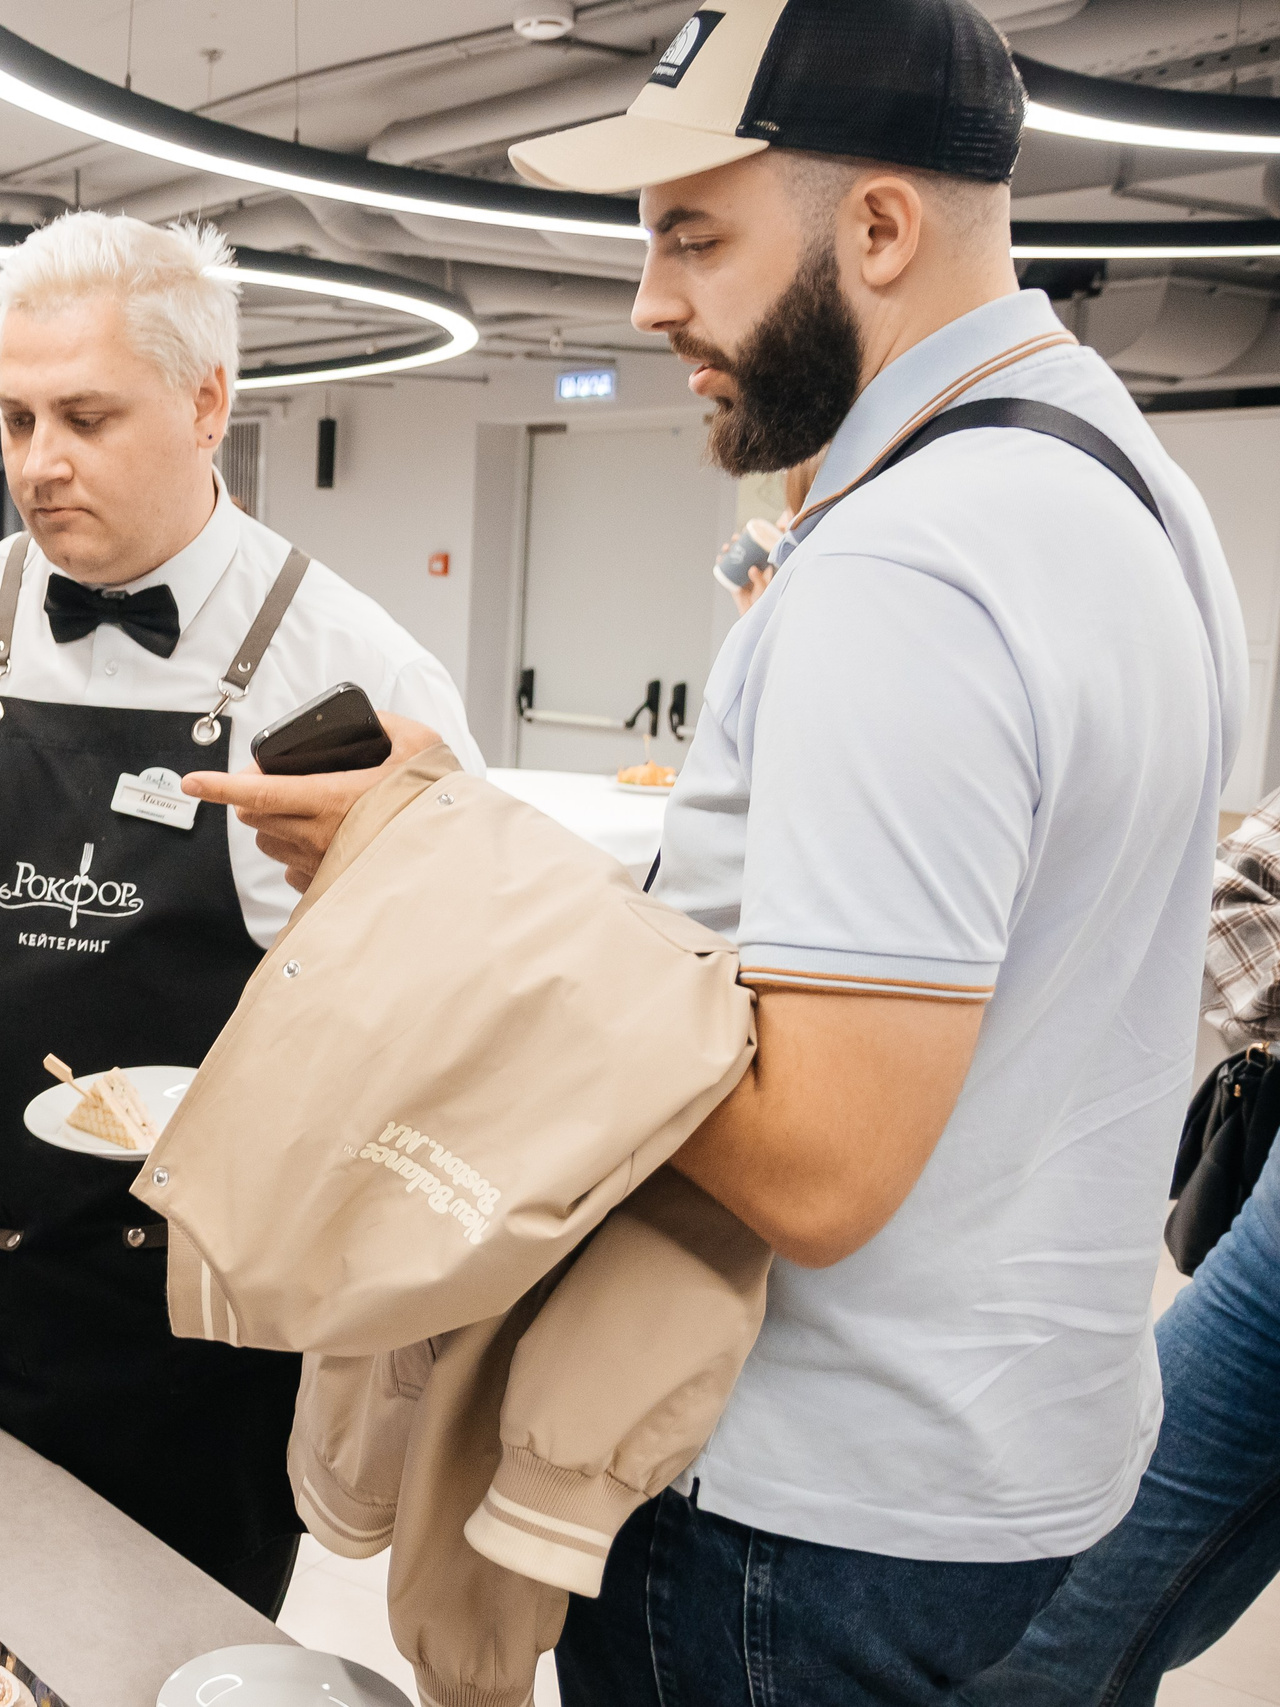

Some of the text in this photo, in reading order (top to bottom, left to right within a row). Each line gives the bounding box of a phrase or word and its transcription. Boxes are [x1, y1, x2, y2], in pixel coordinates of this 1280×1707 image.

[139, 792, 177, 811] Михаил
[18, 932, 111, 954] КЕЙТЕРИНГ
[359, 1141, 455, 1214] Balance
[448, 1198, 490, 1245] New
